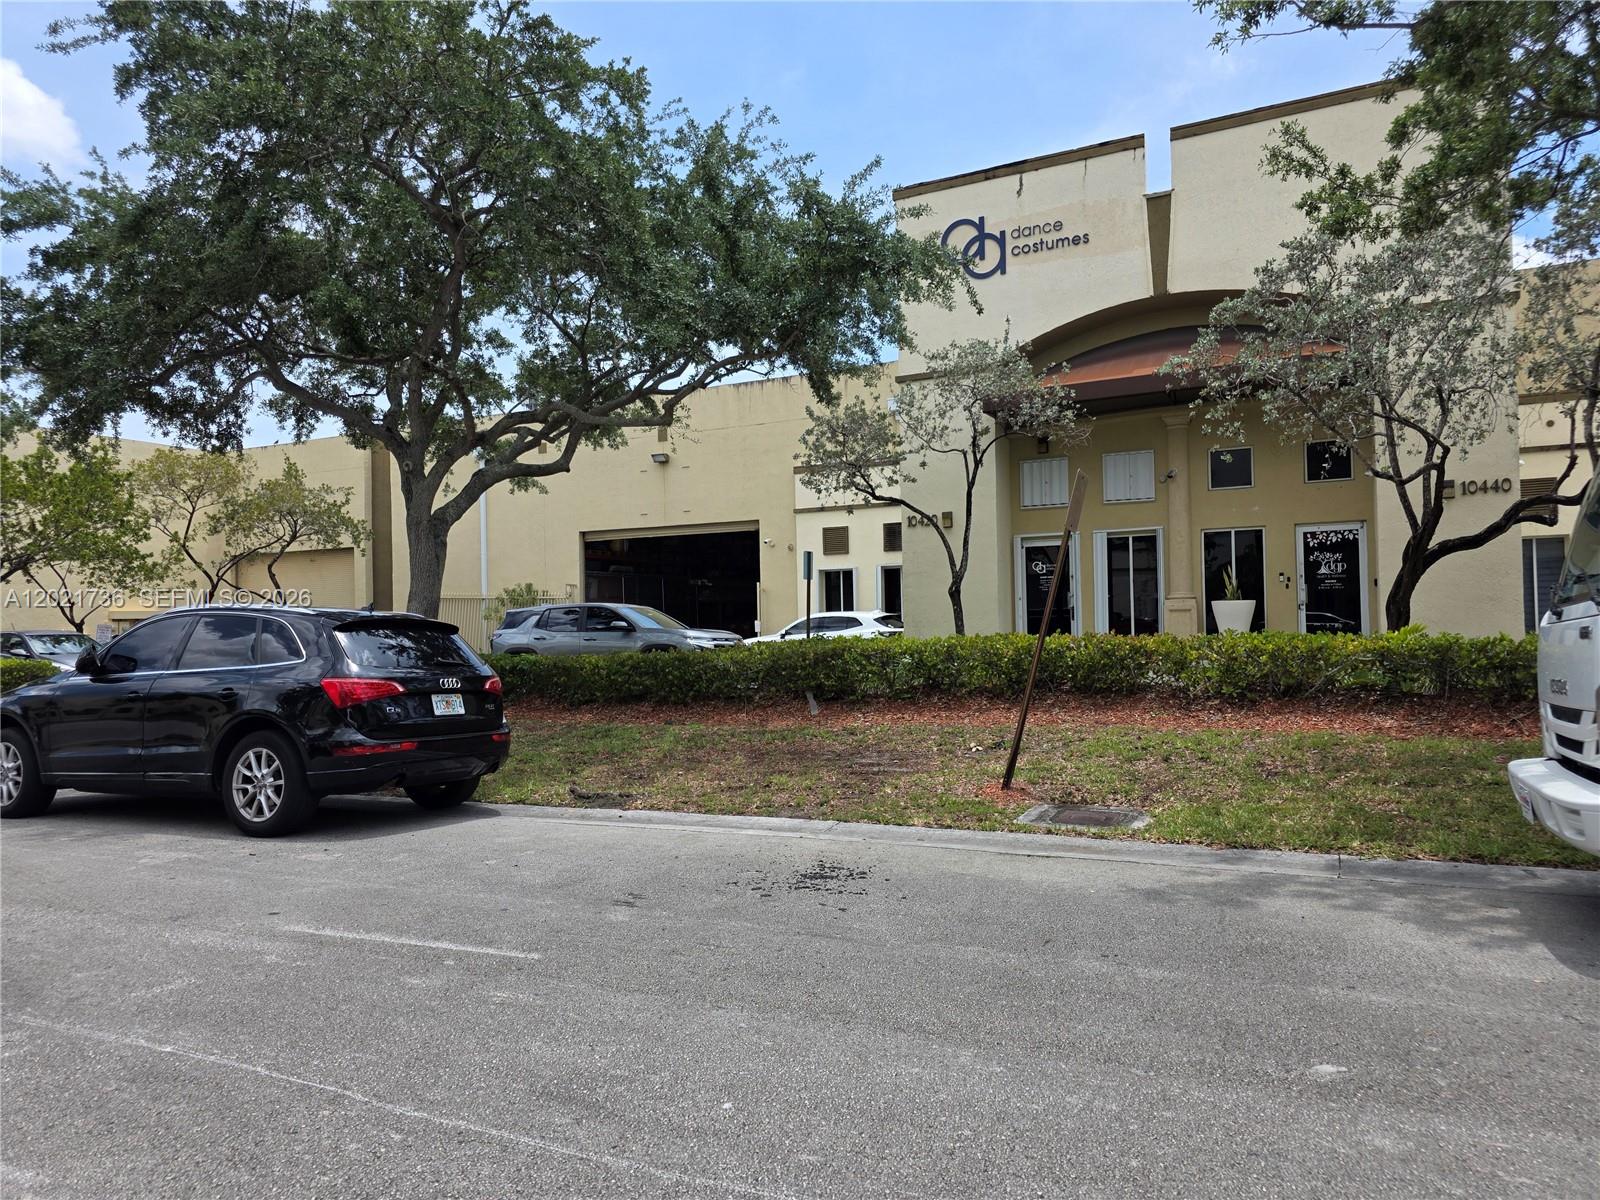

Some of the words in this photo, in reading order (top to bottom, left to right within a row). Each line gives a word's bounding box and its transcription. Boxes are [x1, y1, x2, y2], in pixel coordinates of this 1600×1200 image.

[1011, 220, 1063, 240] dance
[1011, 232, 1090, 257] costumes
[1460, 477, 1512, 496] 10440
